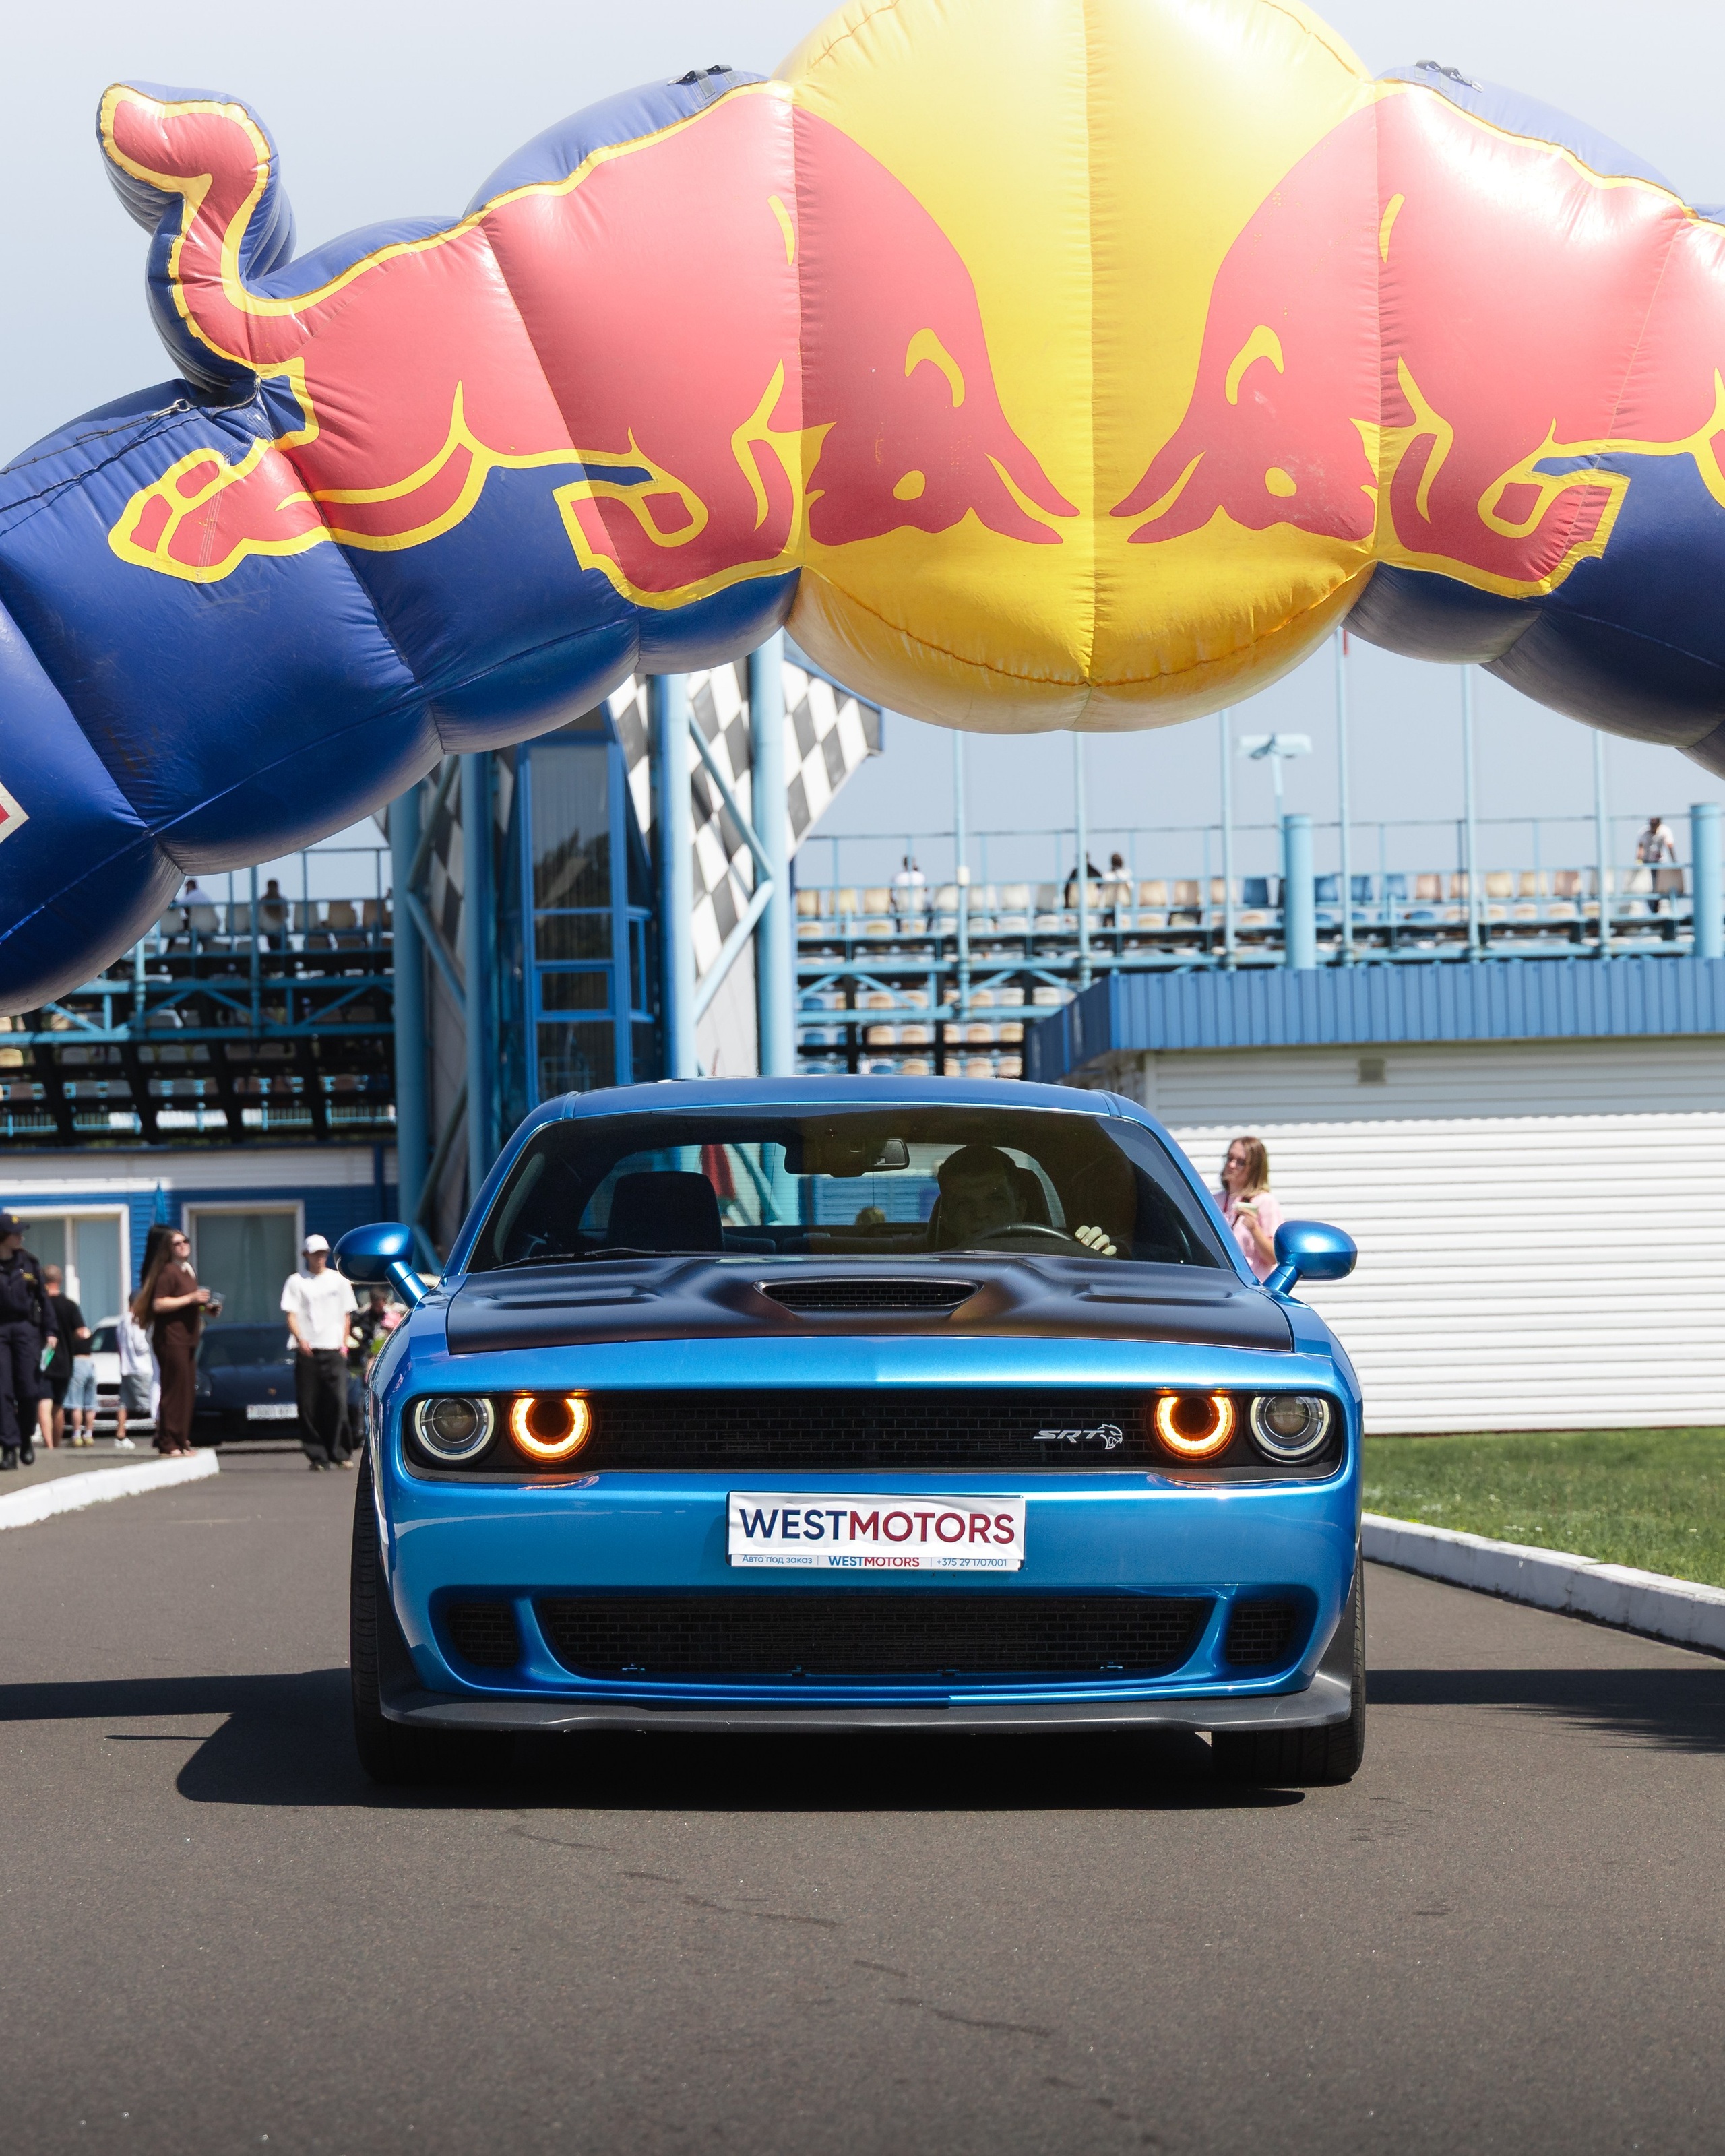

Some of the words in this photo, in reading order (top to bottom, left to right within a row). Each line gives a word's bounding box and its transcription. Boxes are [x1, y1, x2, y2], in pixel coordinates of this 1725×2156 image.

[1033, 1430, 1105, 1443] SRT
[739, 1508, 1015, 1544] WESTMOTORS
[742, 1555, 764, 1563] Авто
[766, 1556, 784, 1564] под
[828, 1556, 920, 1567] WESTMOTORS
[937, 1558, 958, 1566] +375
[960, 1558, 970, 1566] 29
[972, 1558, 1007, 1567] 1707001
